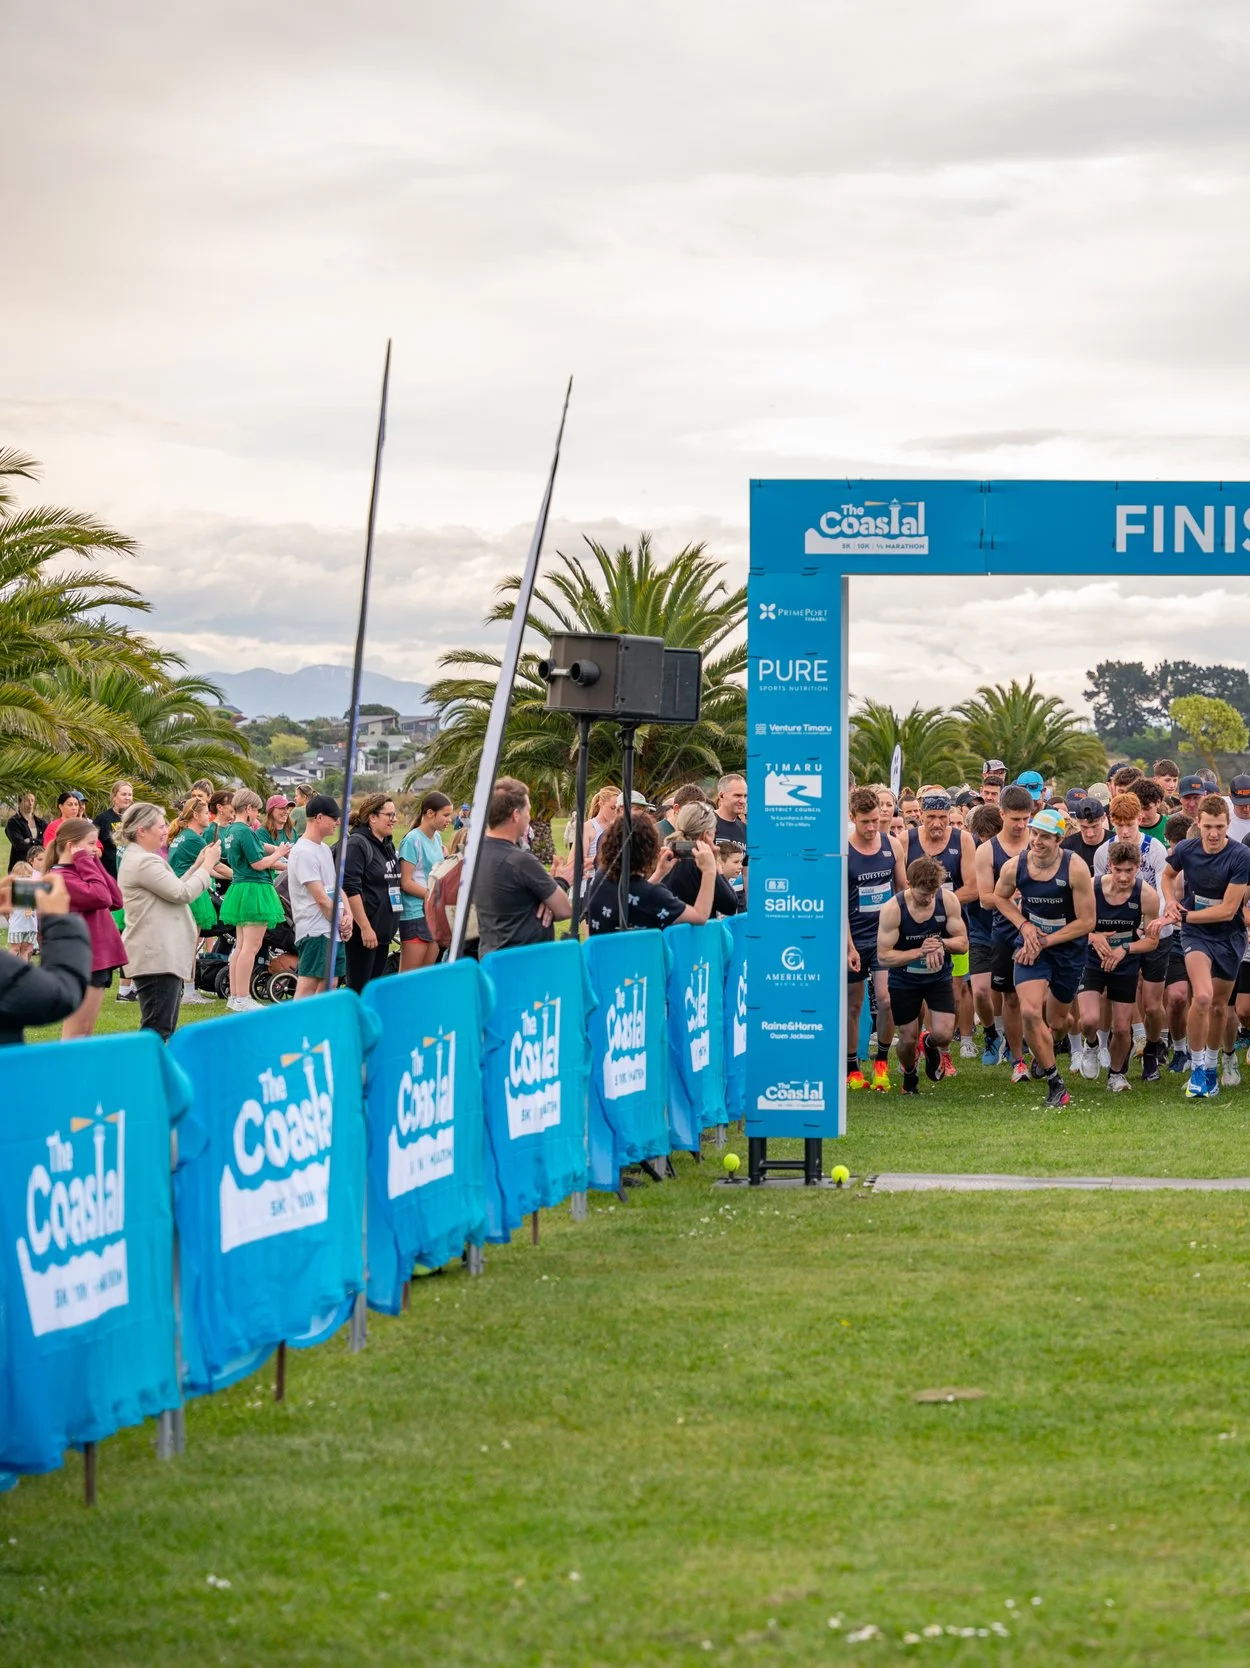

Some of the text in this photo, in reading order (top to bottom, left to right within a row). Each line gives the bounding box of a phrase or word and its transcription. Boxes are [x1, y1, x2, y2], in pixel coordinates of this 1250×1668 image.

[841, 504, 865, 516] The
[759, 659, 828, 681] PURE
[769, 724, 832, 732] Venture Timaru
[765, 763, 823, 772] TIMARU
[764, 895, 824, 912] saikou
[765, 973, 820, 981] AMERIKIWI
[521, 1009, 537, 1037] The
[258, 1067, 288, 1104] The
[46, 1130, 74, 1173] The
